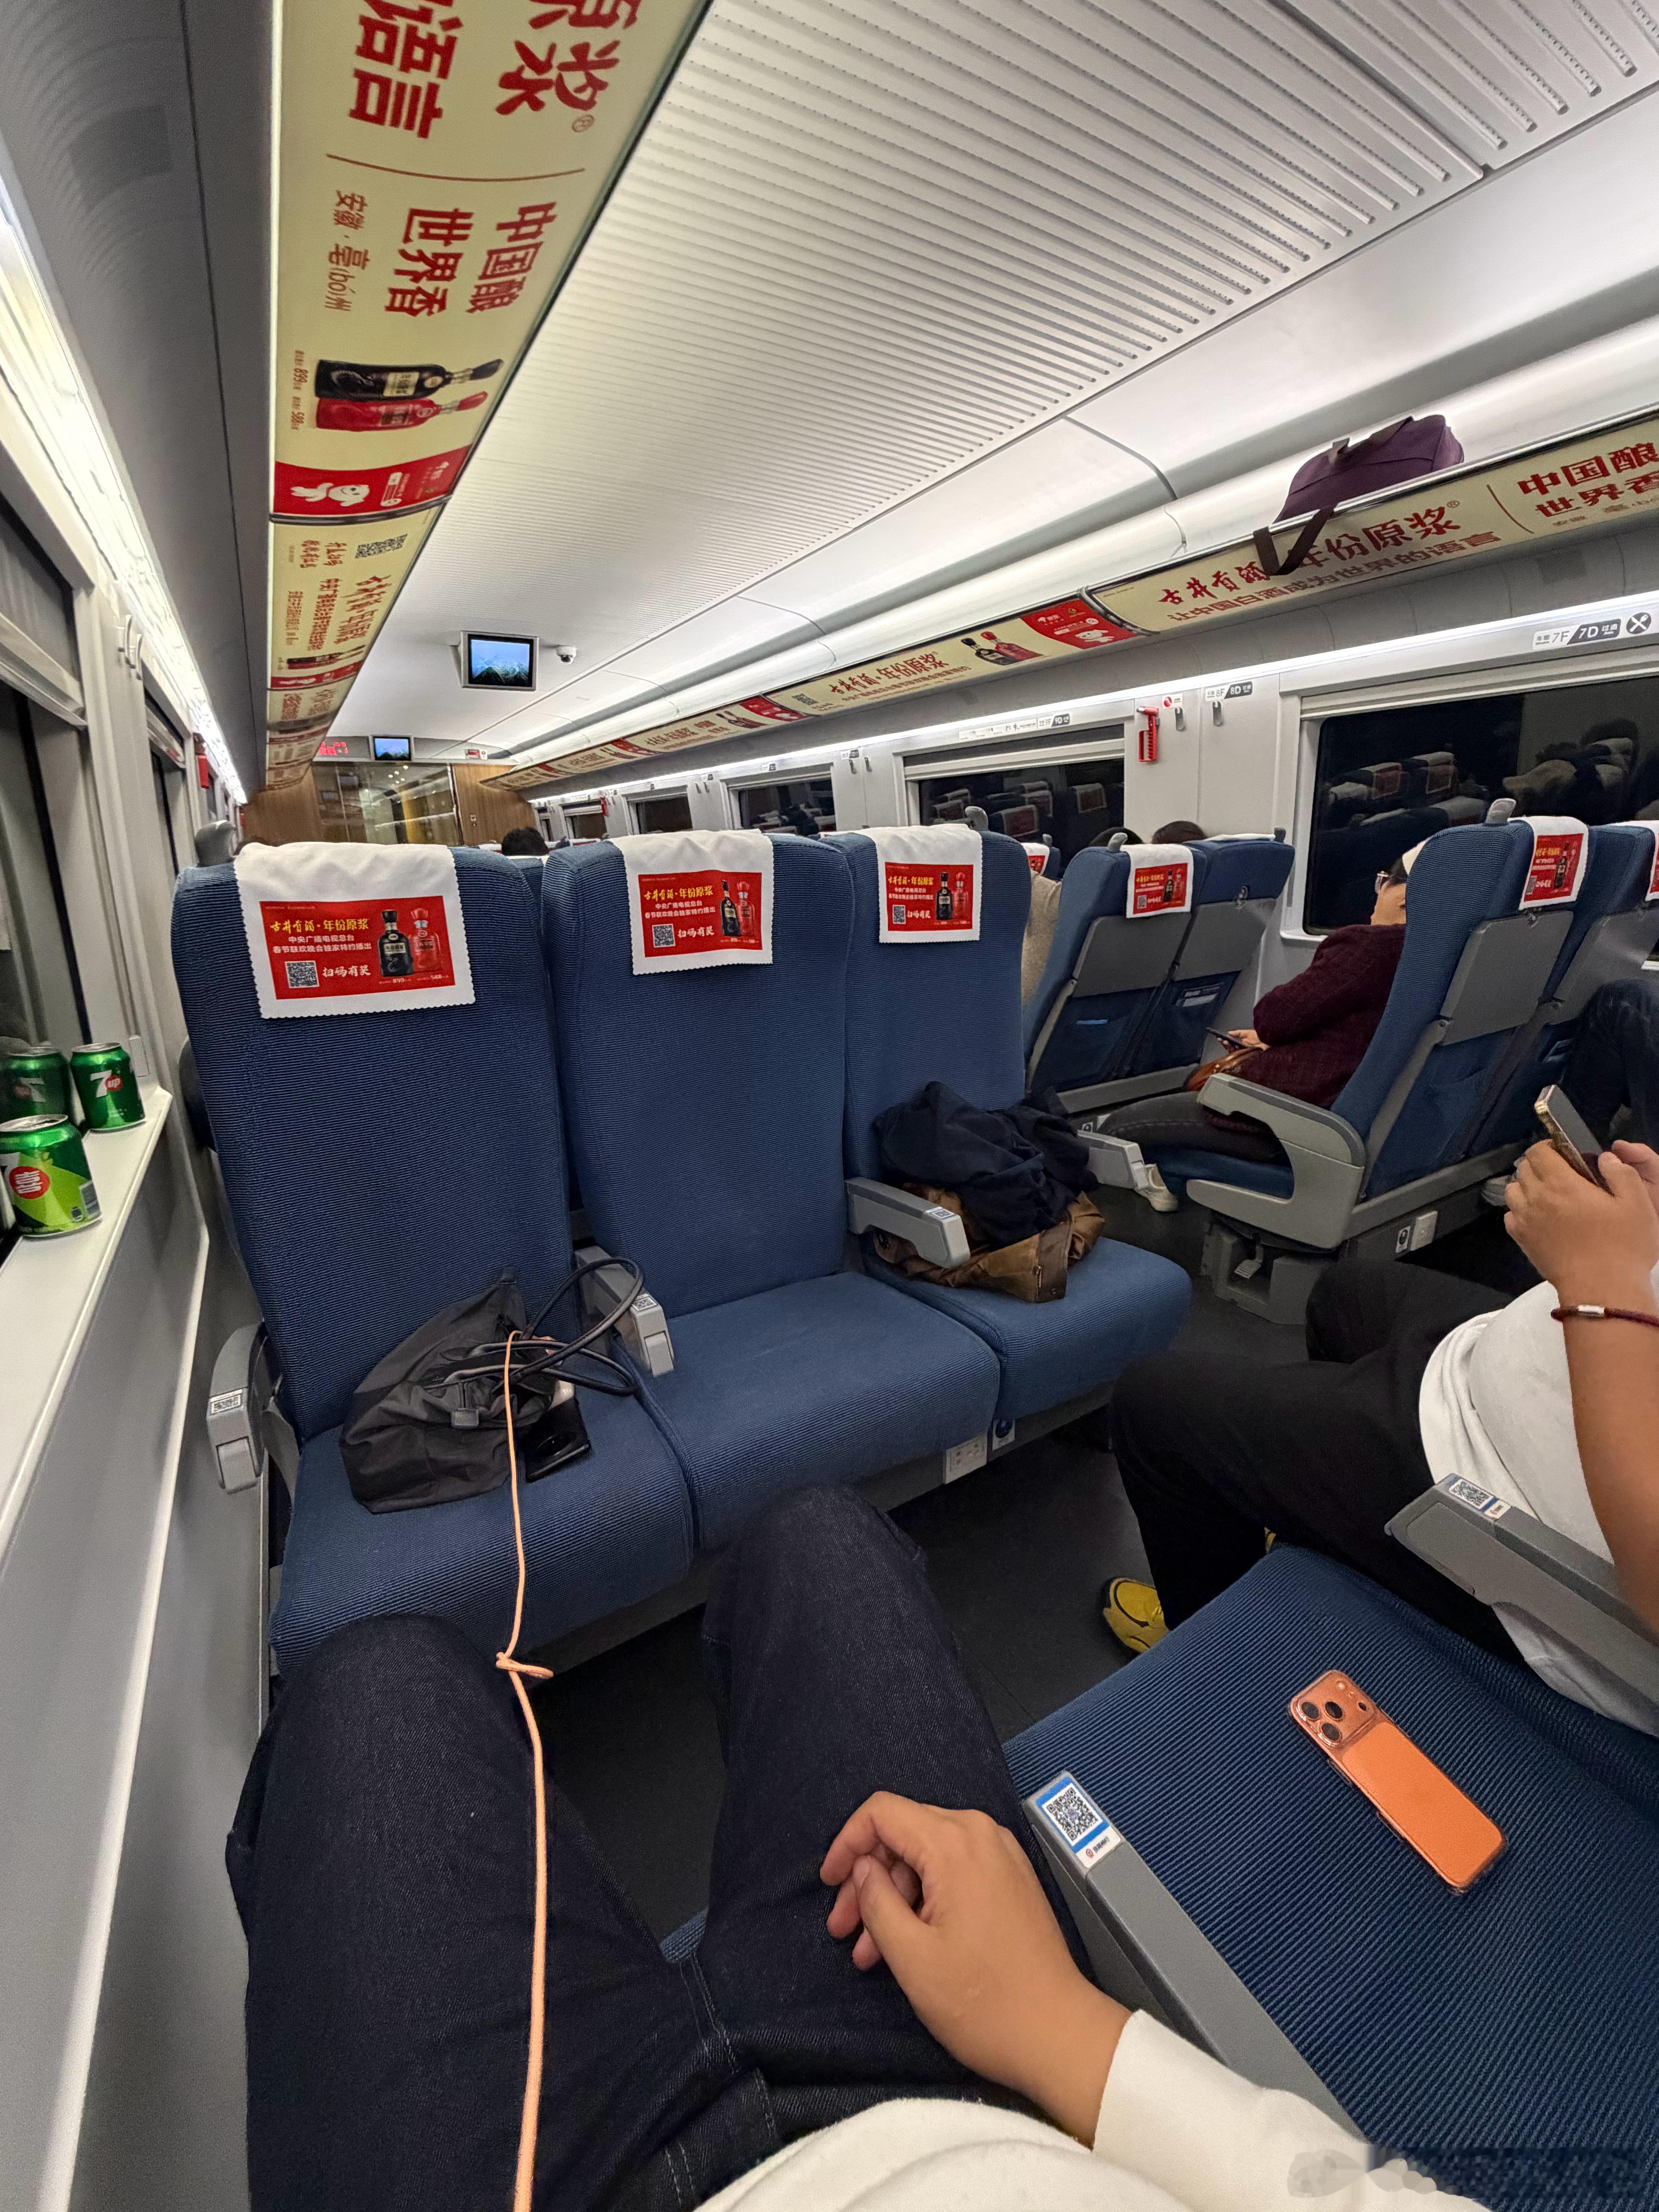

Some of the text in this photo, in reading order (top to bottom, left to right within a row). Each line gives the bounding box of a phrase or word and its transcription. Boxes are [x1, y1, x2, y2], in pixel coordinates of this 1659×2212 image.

[349, 0, 463, 138] 语言
[385, 208, 473, 316] 世界香
[466, 202, 556, 313] 中国酿
[1518, 443, 1659, 495] 中国酿
[1167, 531, 1502, 621] 让中国白酒成为世界的语言
[1552, 631, 1569, 643] 7F
[1578, 626, 1598, 639] 7D
[1230, 686, 1241, 695] 8D
[644, 885, 713, 901] 古井贡酒·年份原浆
[655, 900, 702, 909] 中央广播电视总台
[270, 918, 369, 934] 古井贡酒·年份原浆
[677, 926, 715, 938] 扫码有奖
[288, 934, 355, 943] 中央广播电视总台
[273, 943, 372, 953] 春节联欢晚会独家特约播出
[322, 965, 371, 978] 扫码有奖
